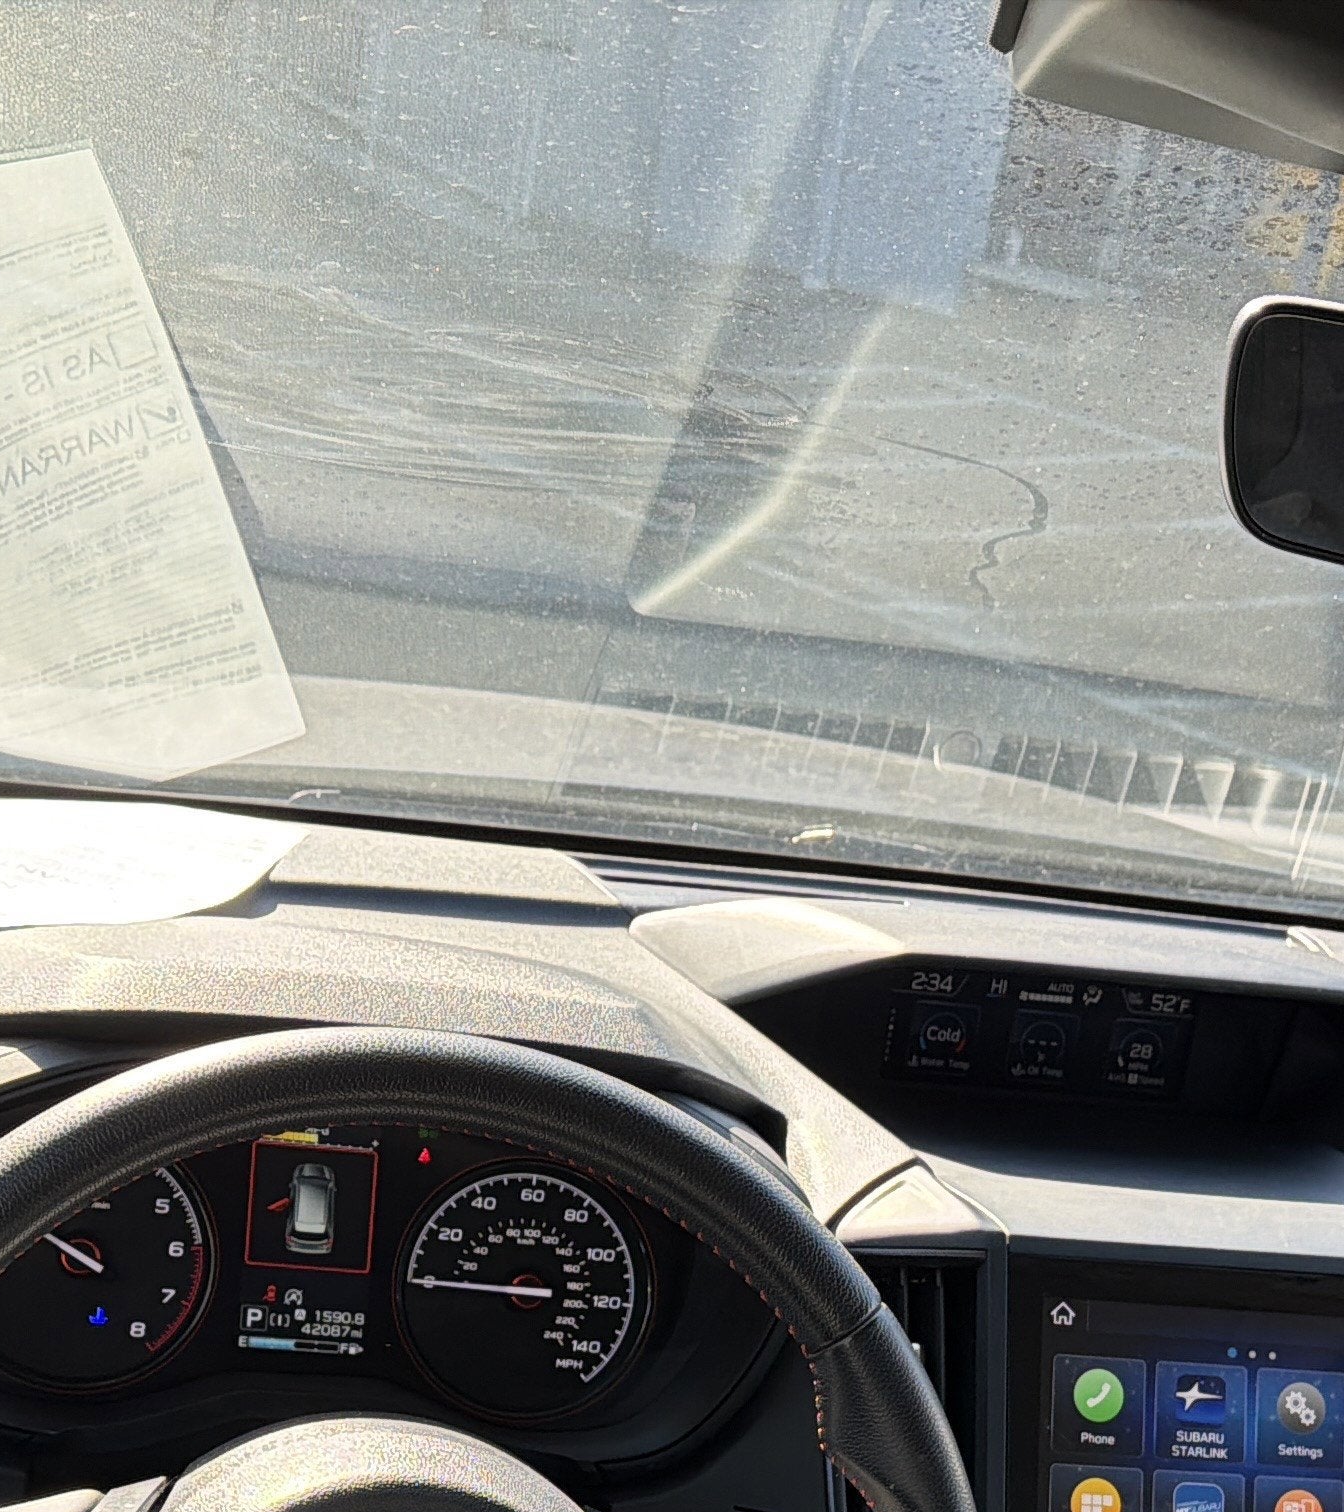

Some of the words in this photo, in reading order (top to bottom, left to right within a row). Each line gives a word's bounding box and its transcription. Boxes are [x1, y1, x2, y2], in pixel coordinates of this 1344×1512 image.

[926, 1026, 962, 1042] Cold
[520, 1189, 546, 1203] 60
[154, 1199, 170, 1214] 5
[471, 1197, 497, 1211] 40
[563, 1209, 589, 1223] 80
[438, 1228, 463, 1242] 20
[168, 1241, 184, 1257] 6
[586, 1247, 616, 1263] 100
[161, 1288, 176, 1303] 7
[593, 1295, 621, 1310] 120
[246, 1308, 263, 1328] P
[315, 1309, 365, 1326] 1590.8
[129, 1321, 146, 1338] 8
[238, 1335, 249, 1348] E
[571, 1340, 601, 1354] 140
[555, 1359, 584, 1370] MPH
[1080, 1431, 1115, 1447] Phone
[1175, 1429, 1225, 1446] SUBARU
[1170, 1444, 1228, 1460] STARLINK
[1277, 1444, 1323, 1460] Settings
